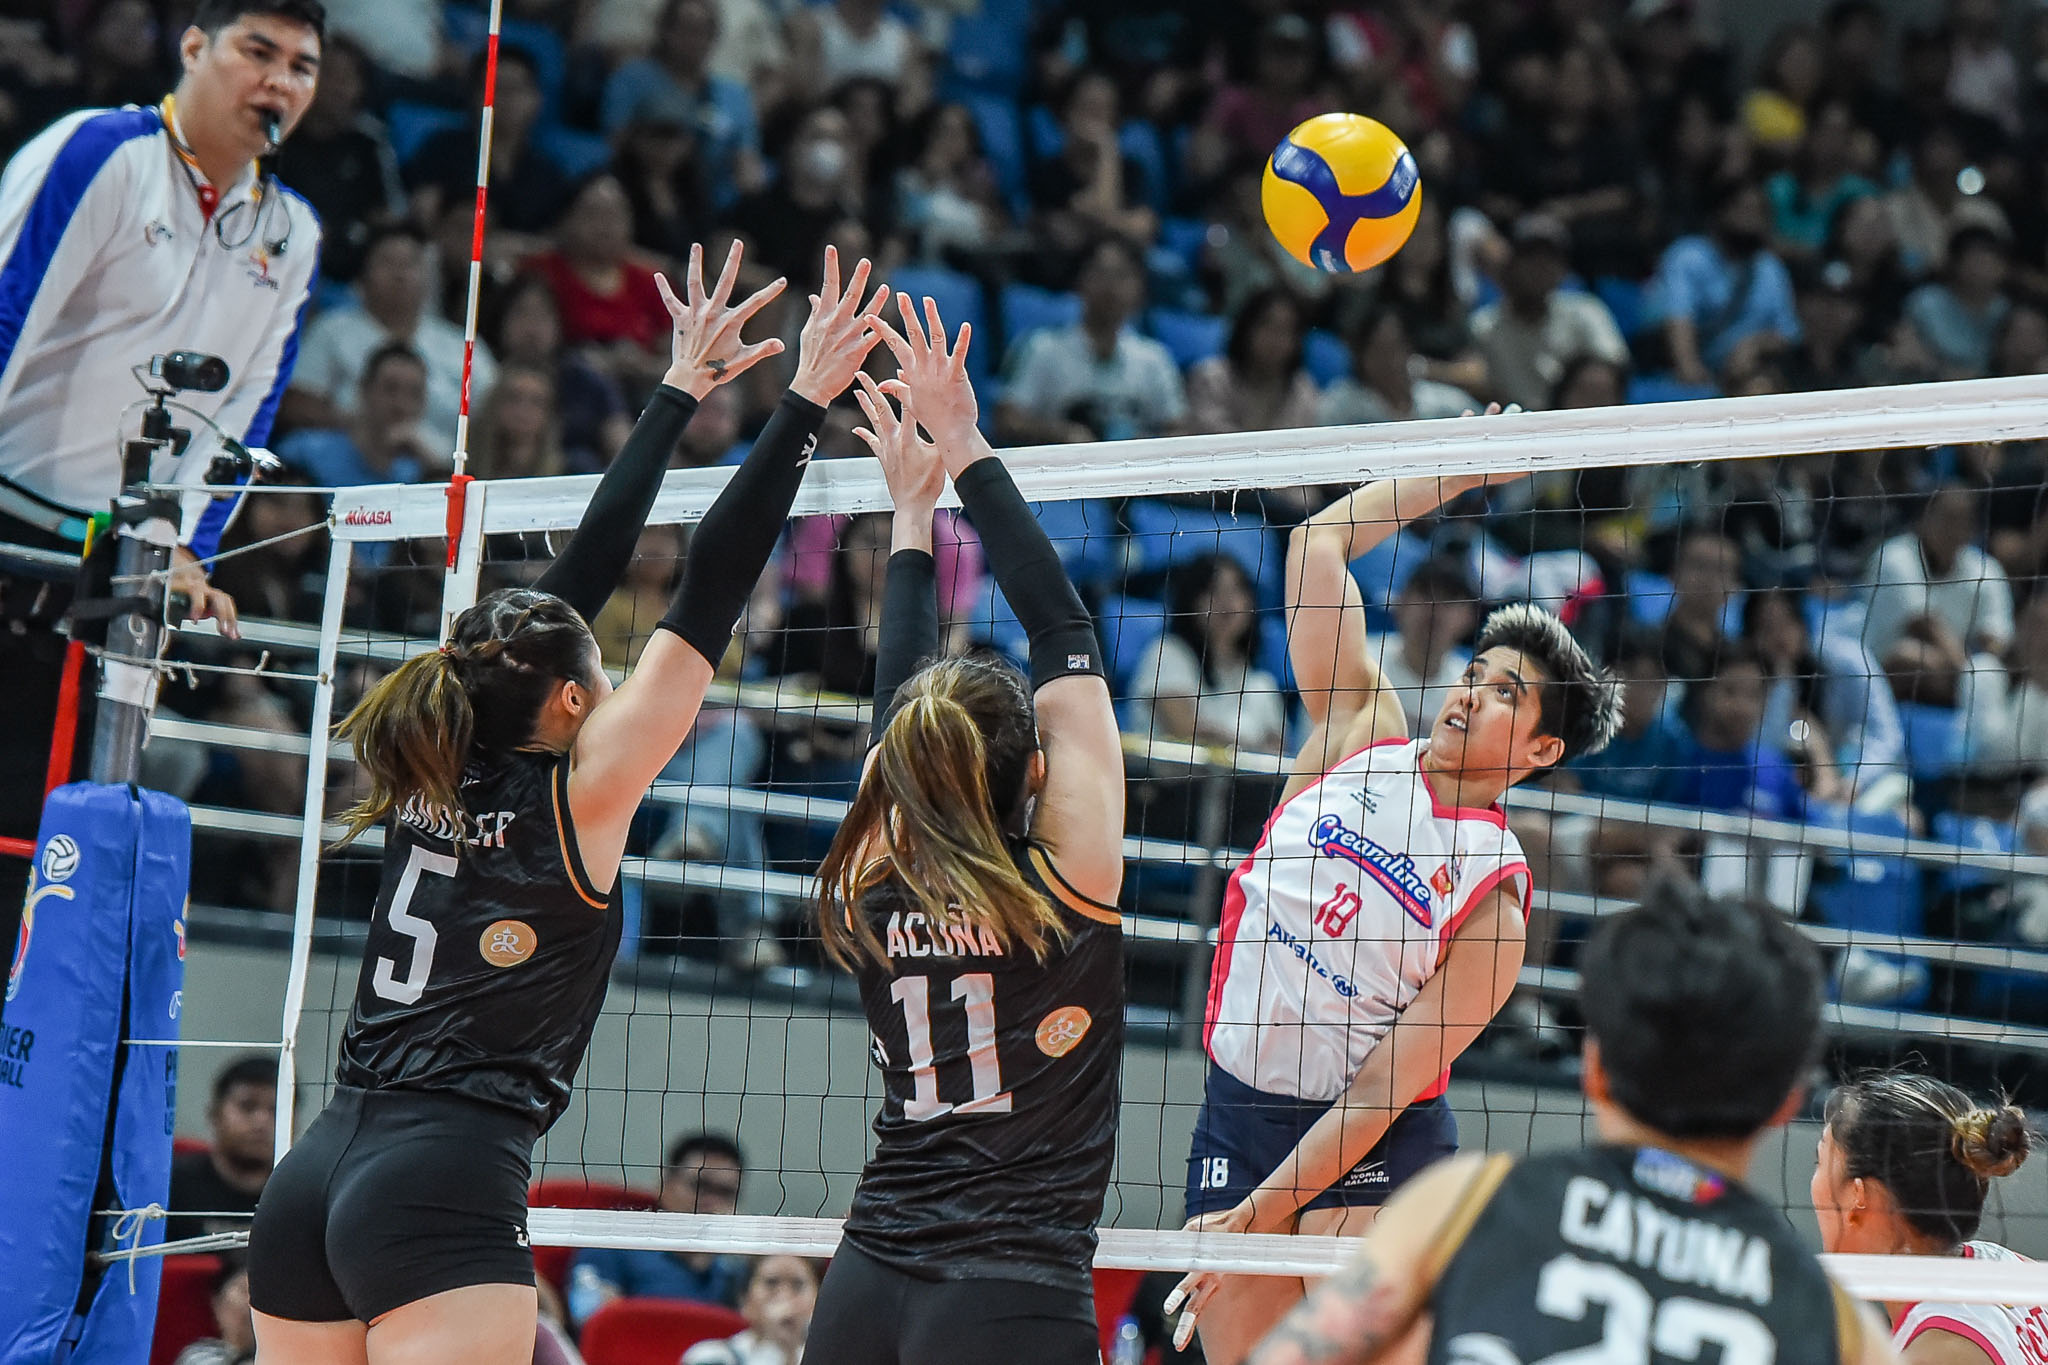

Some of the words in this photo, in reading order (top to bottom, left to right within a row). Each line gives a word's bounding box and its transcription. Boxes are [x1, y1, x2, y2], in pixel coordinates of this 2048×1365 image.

[345, 506, 392, 526] MIKASA
[1309, 814, 1430, 903] Creamline
[372, 844, 459, 1005] 5
[1314, 883, 1363, 938] 18
[890, 973, 1013, 1122] 11
[1200, 1157, 1229, 1190] 18
[1350, 1171, 1385, 1180] WORLD
[1560, 1174, 1773, 1306] CAYUNA
